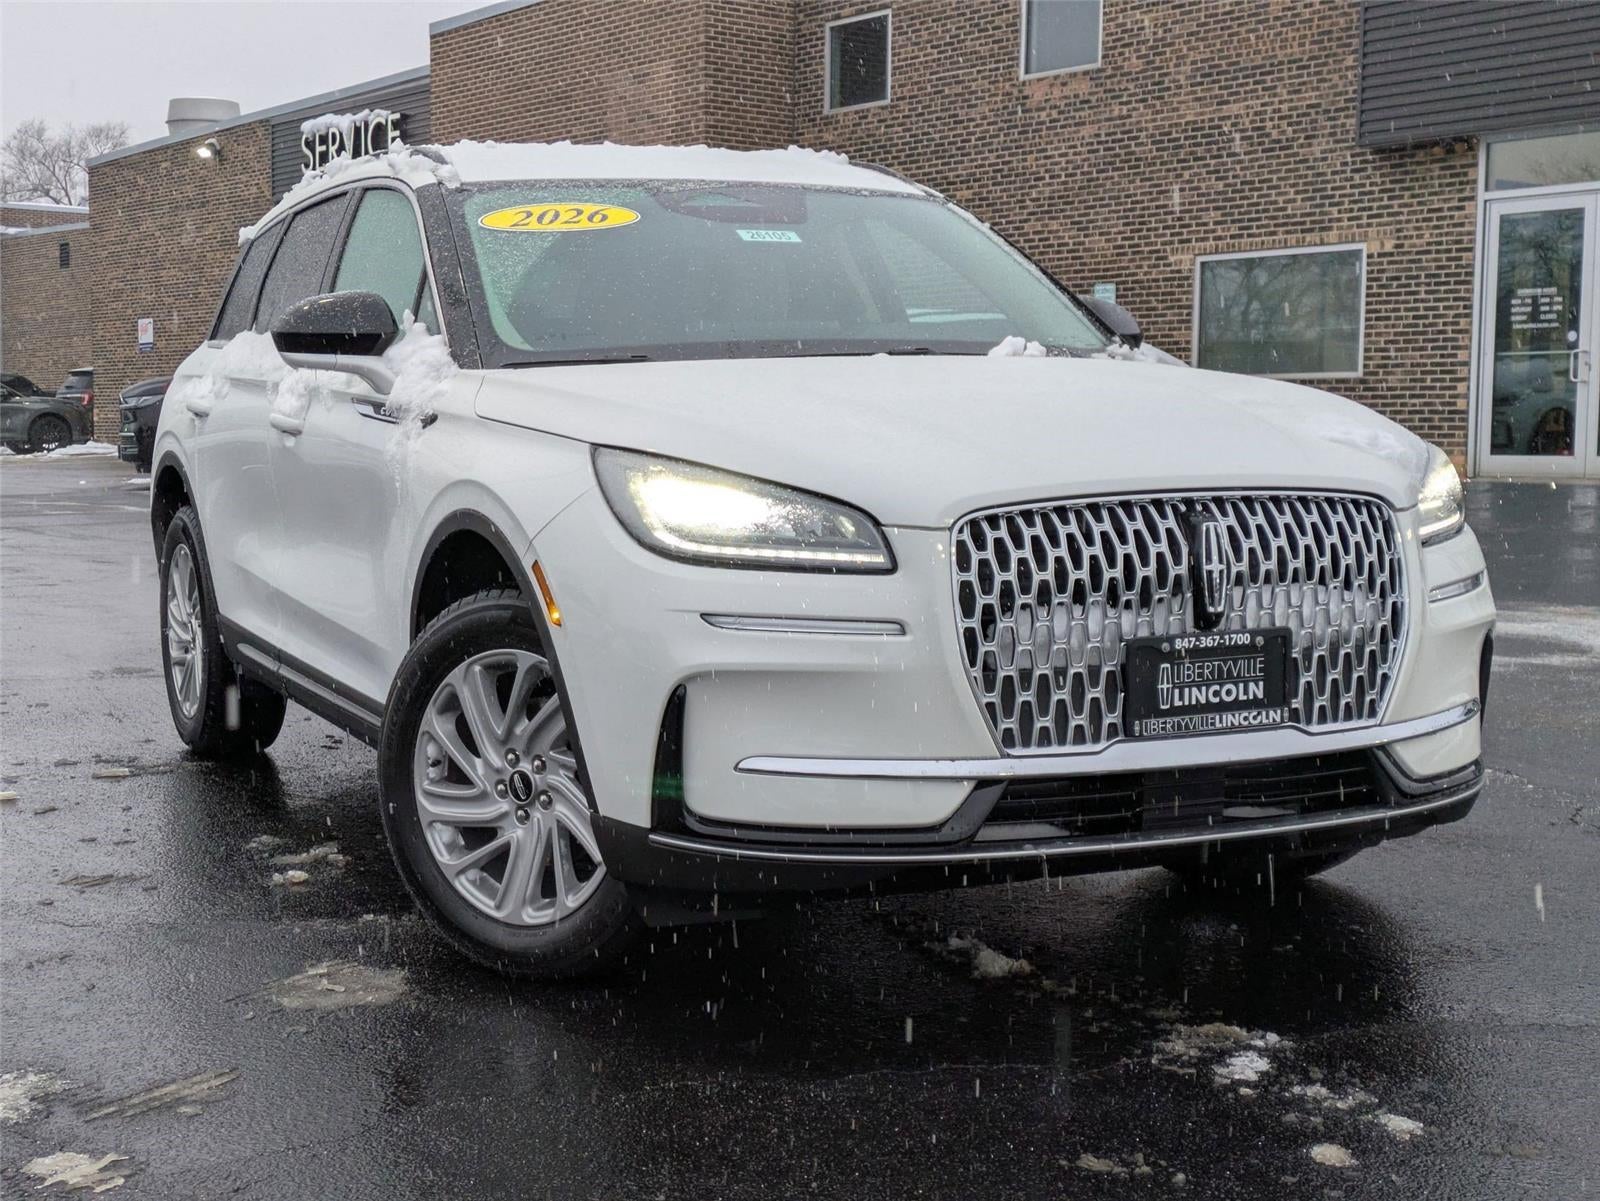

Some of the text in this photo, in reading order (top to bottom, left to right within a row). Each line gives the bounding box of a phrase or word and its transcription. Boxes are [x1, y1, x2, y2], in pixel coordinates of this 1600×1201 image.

[301, 112, 401, 175] SERVICE
[509, 208, 611, 228] 2026
[746, 231, 792, 241] 26105
[1175, 632, 1251, 650] 847-367-1700
[1174, 657, 1265, 683] LIBERTYVILLE
[1174, 681, 1264, 707] LINCOLN
